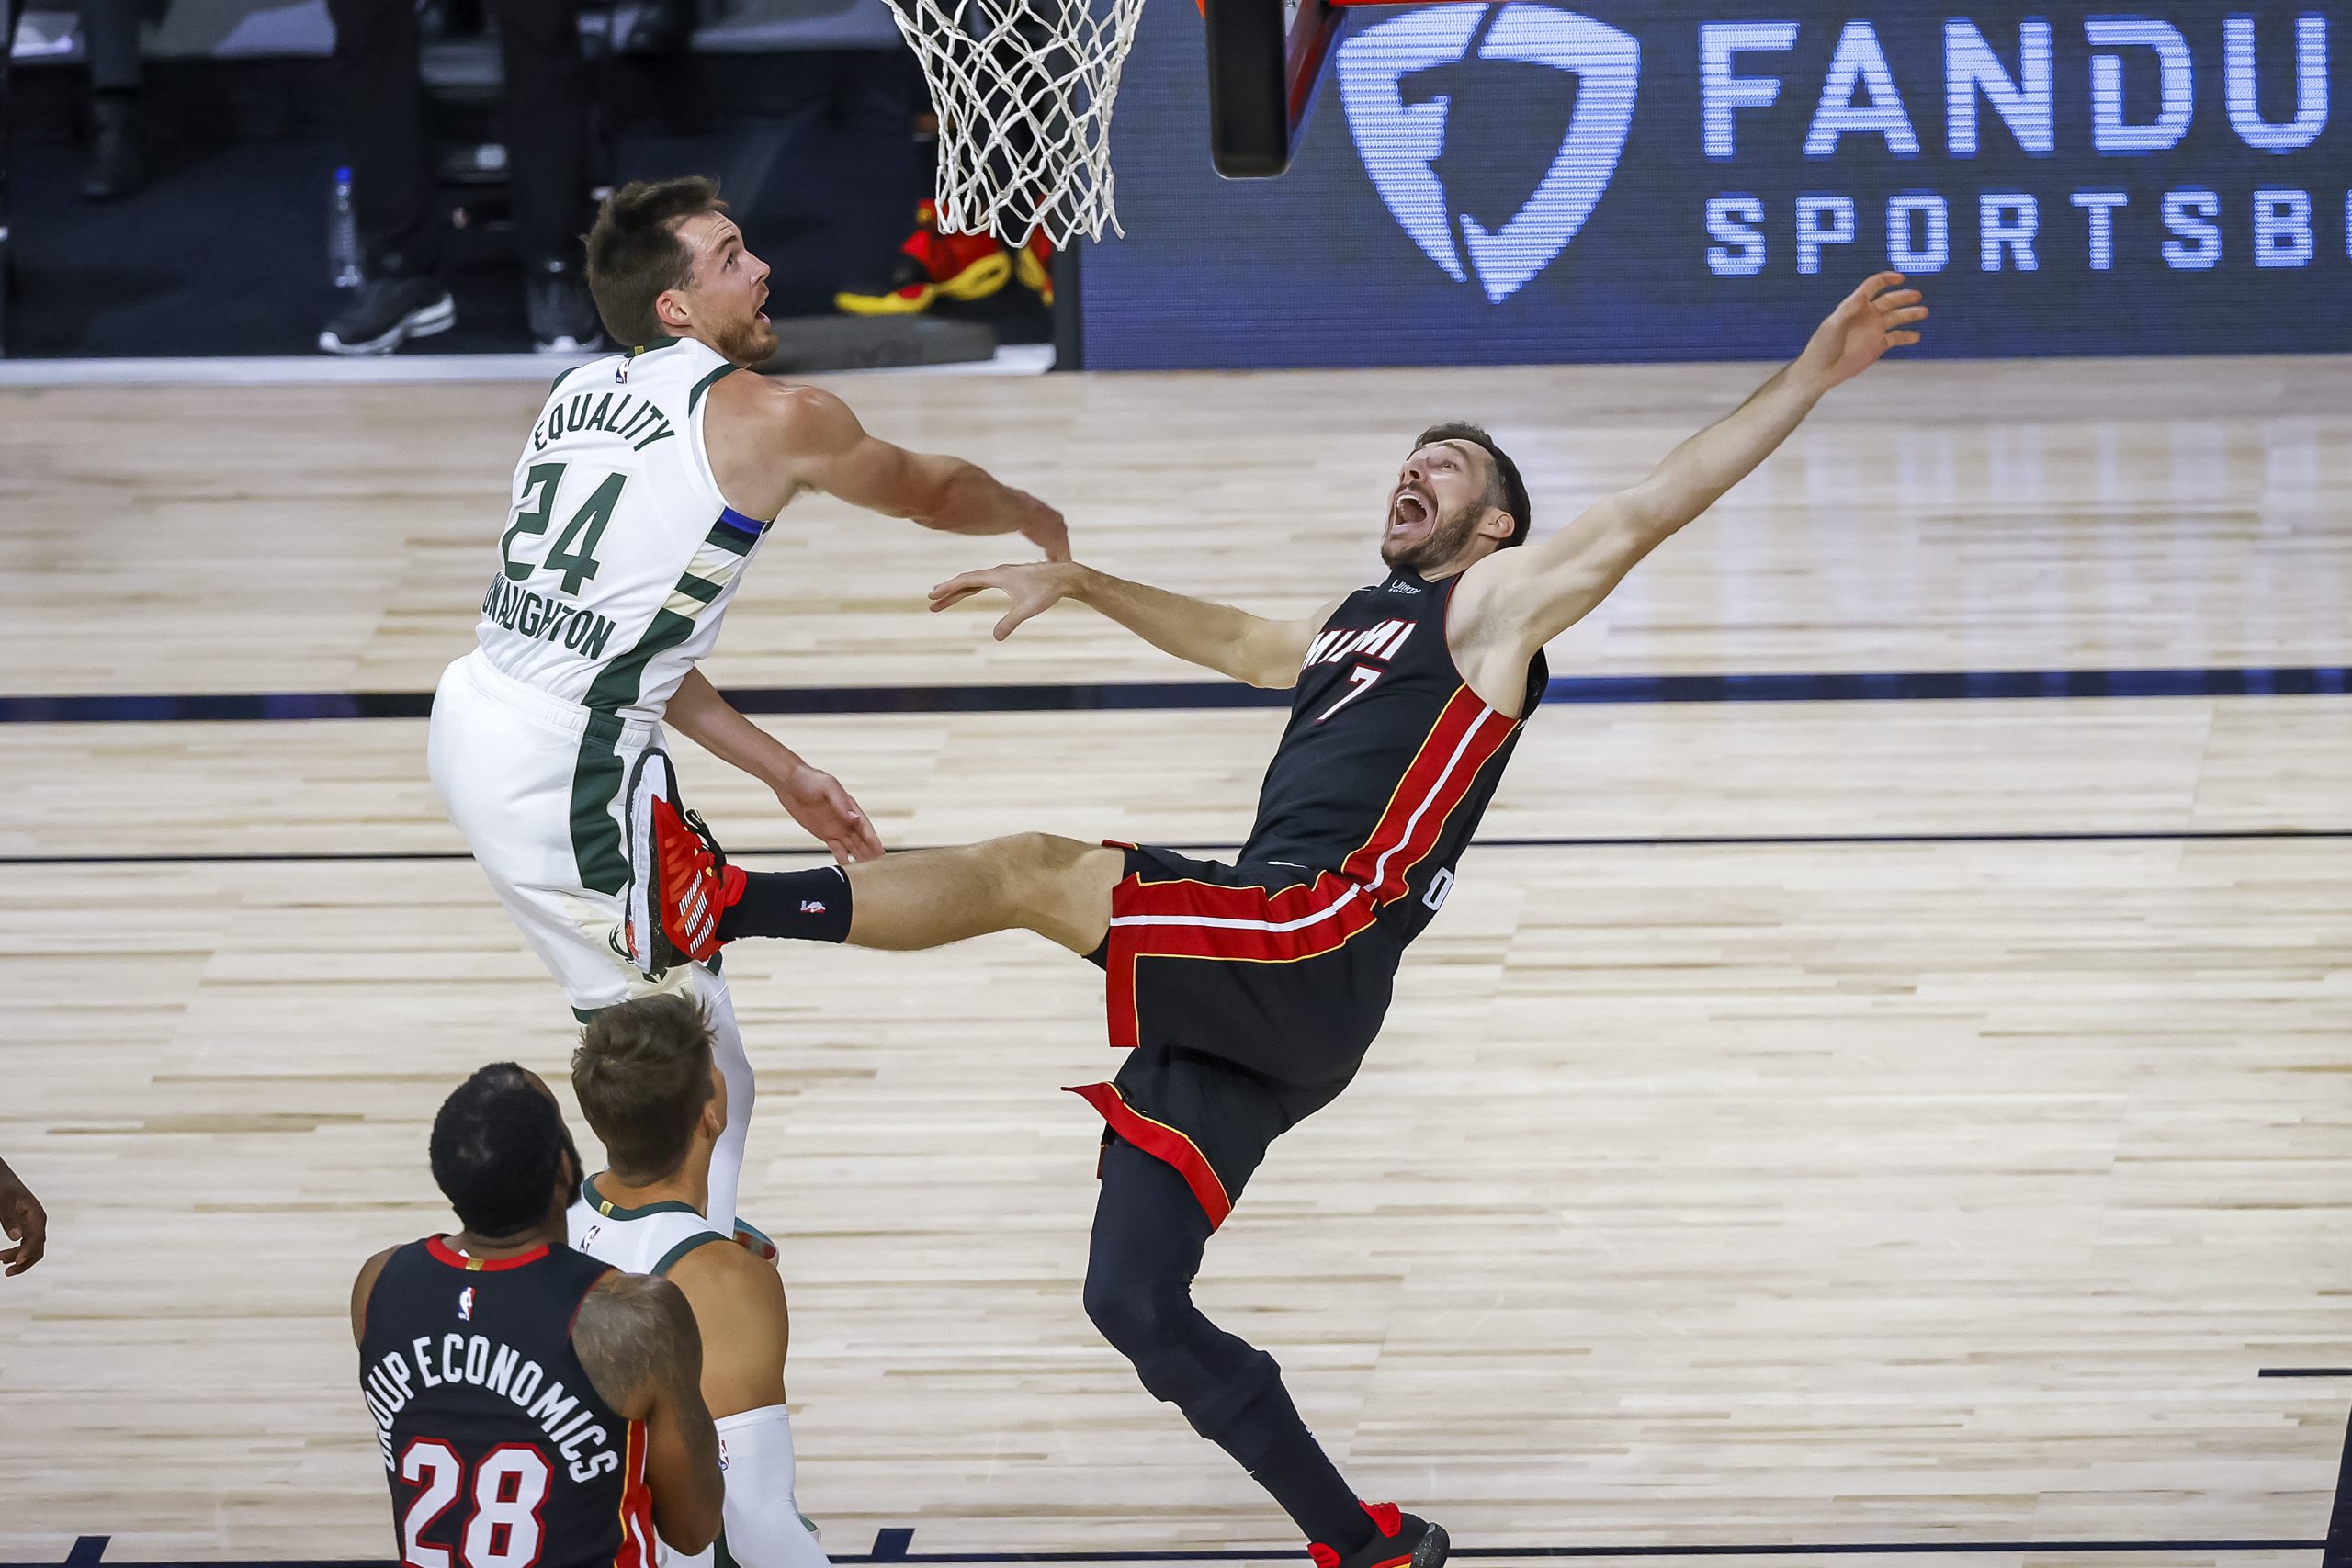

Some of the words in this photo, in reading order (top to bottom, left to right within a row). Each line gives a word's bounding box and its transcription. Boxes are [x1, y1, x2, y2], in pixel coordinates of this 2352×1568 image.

[1705, 189, 2352, 274] SPORTSB
[534, 392, 675, 452] EQUALITY
[502, 462, 628, 597] 24
[1315, 662, 1385, 723] 7
[413, 1333, 619, 1483] ECONOMICS
[399, 1436, 554, 1568] 28
